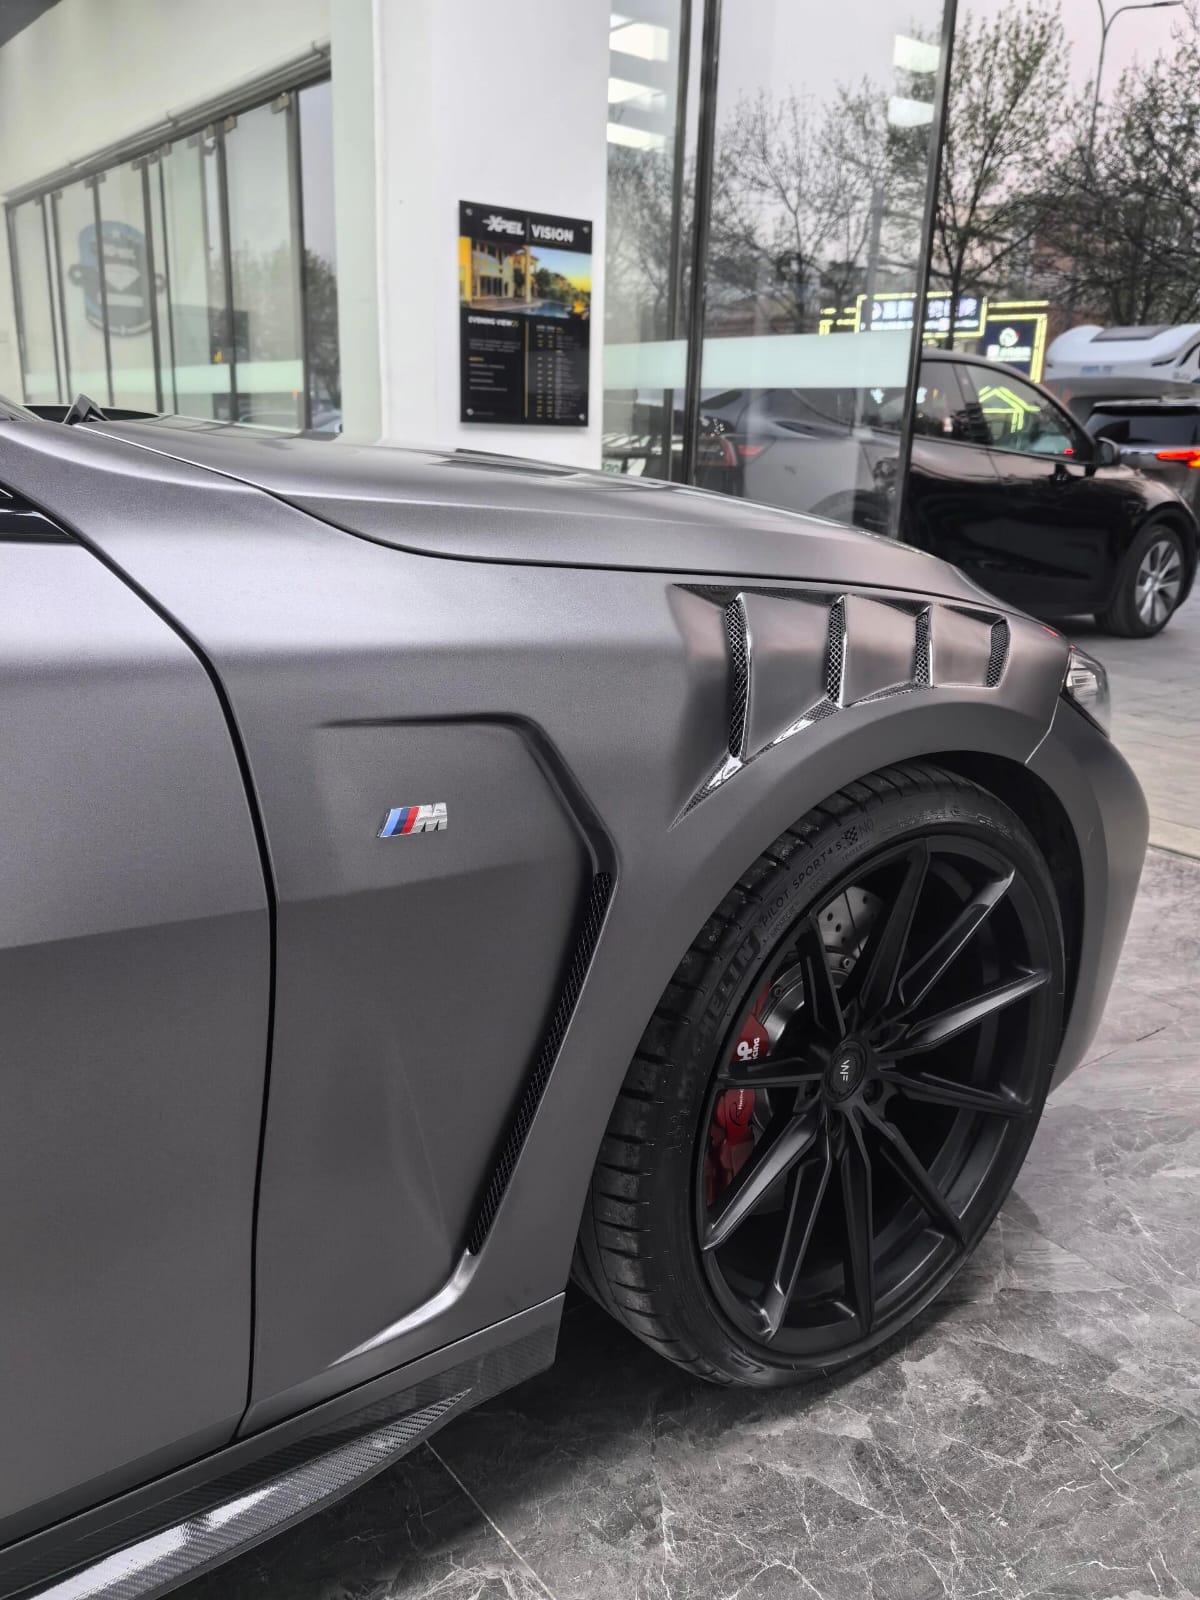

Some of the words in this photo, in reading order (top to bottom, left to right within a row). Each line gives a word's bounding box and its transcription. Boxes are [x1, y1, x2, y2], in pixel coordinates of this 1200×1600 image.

[483, 215, 525, 236] XPEL
[531, 224, 574, 243] VISION
[404, 802, 448, 834] M
[762, 890, 791, 925] PILOT
[792, 850, 827, 889] SPORT
